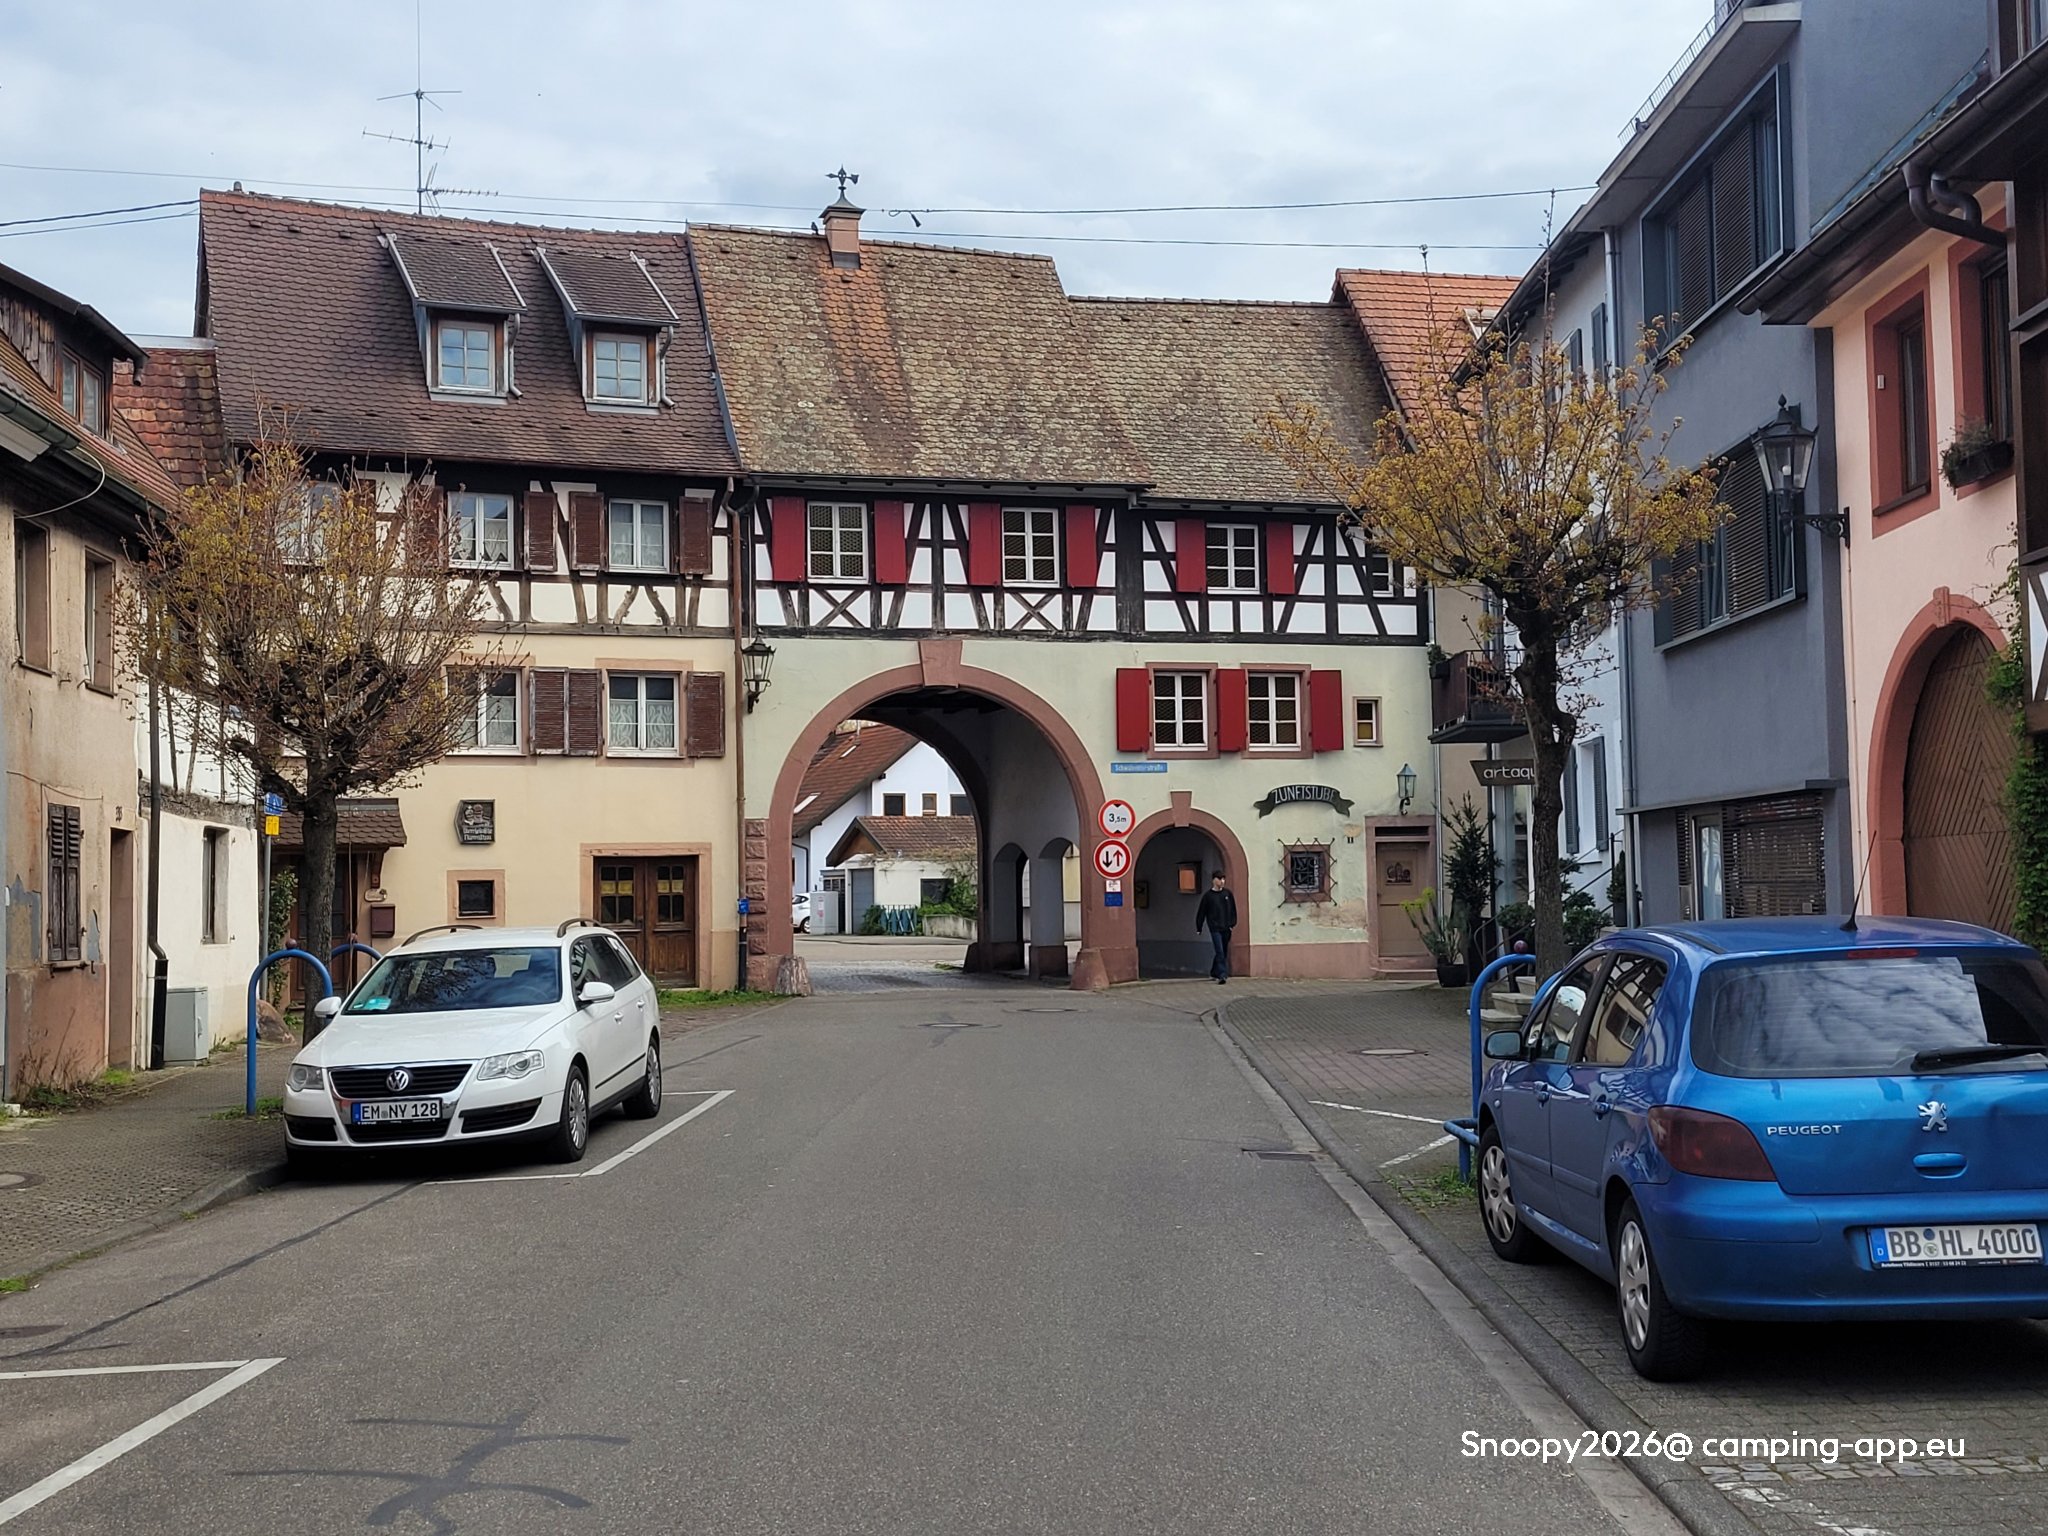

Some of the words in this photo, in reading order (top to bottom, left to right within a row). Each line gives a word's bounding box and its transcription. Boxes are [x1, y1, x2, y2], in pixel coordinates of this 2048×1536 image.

[1271, 785, 1337, 804] ZUNFTSTUBE
[362, 1105, 380, 1120] EM
[389, 1103, 407, 1118] NY
[411, 1102, 438, 1117] 128
[1767, 1125, 1842, 1136] PEUGEOT
[1888, 1231, 1921, 1257] BB
[1939, 1229, 1973, 1256] HL
[1977, 1228, 2037, 1255] 4000
